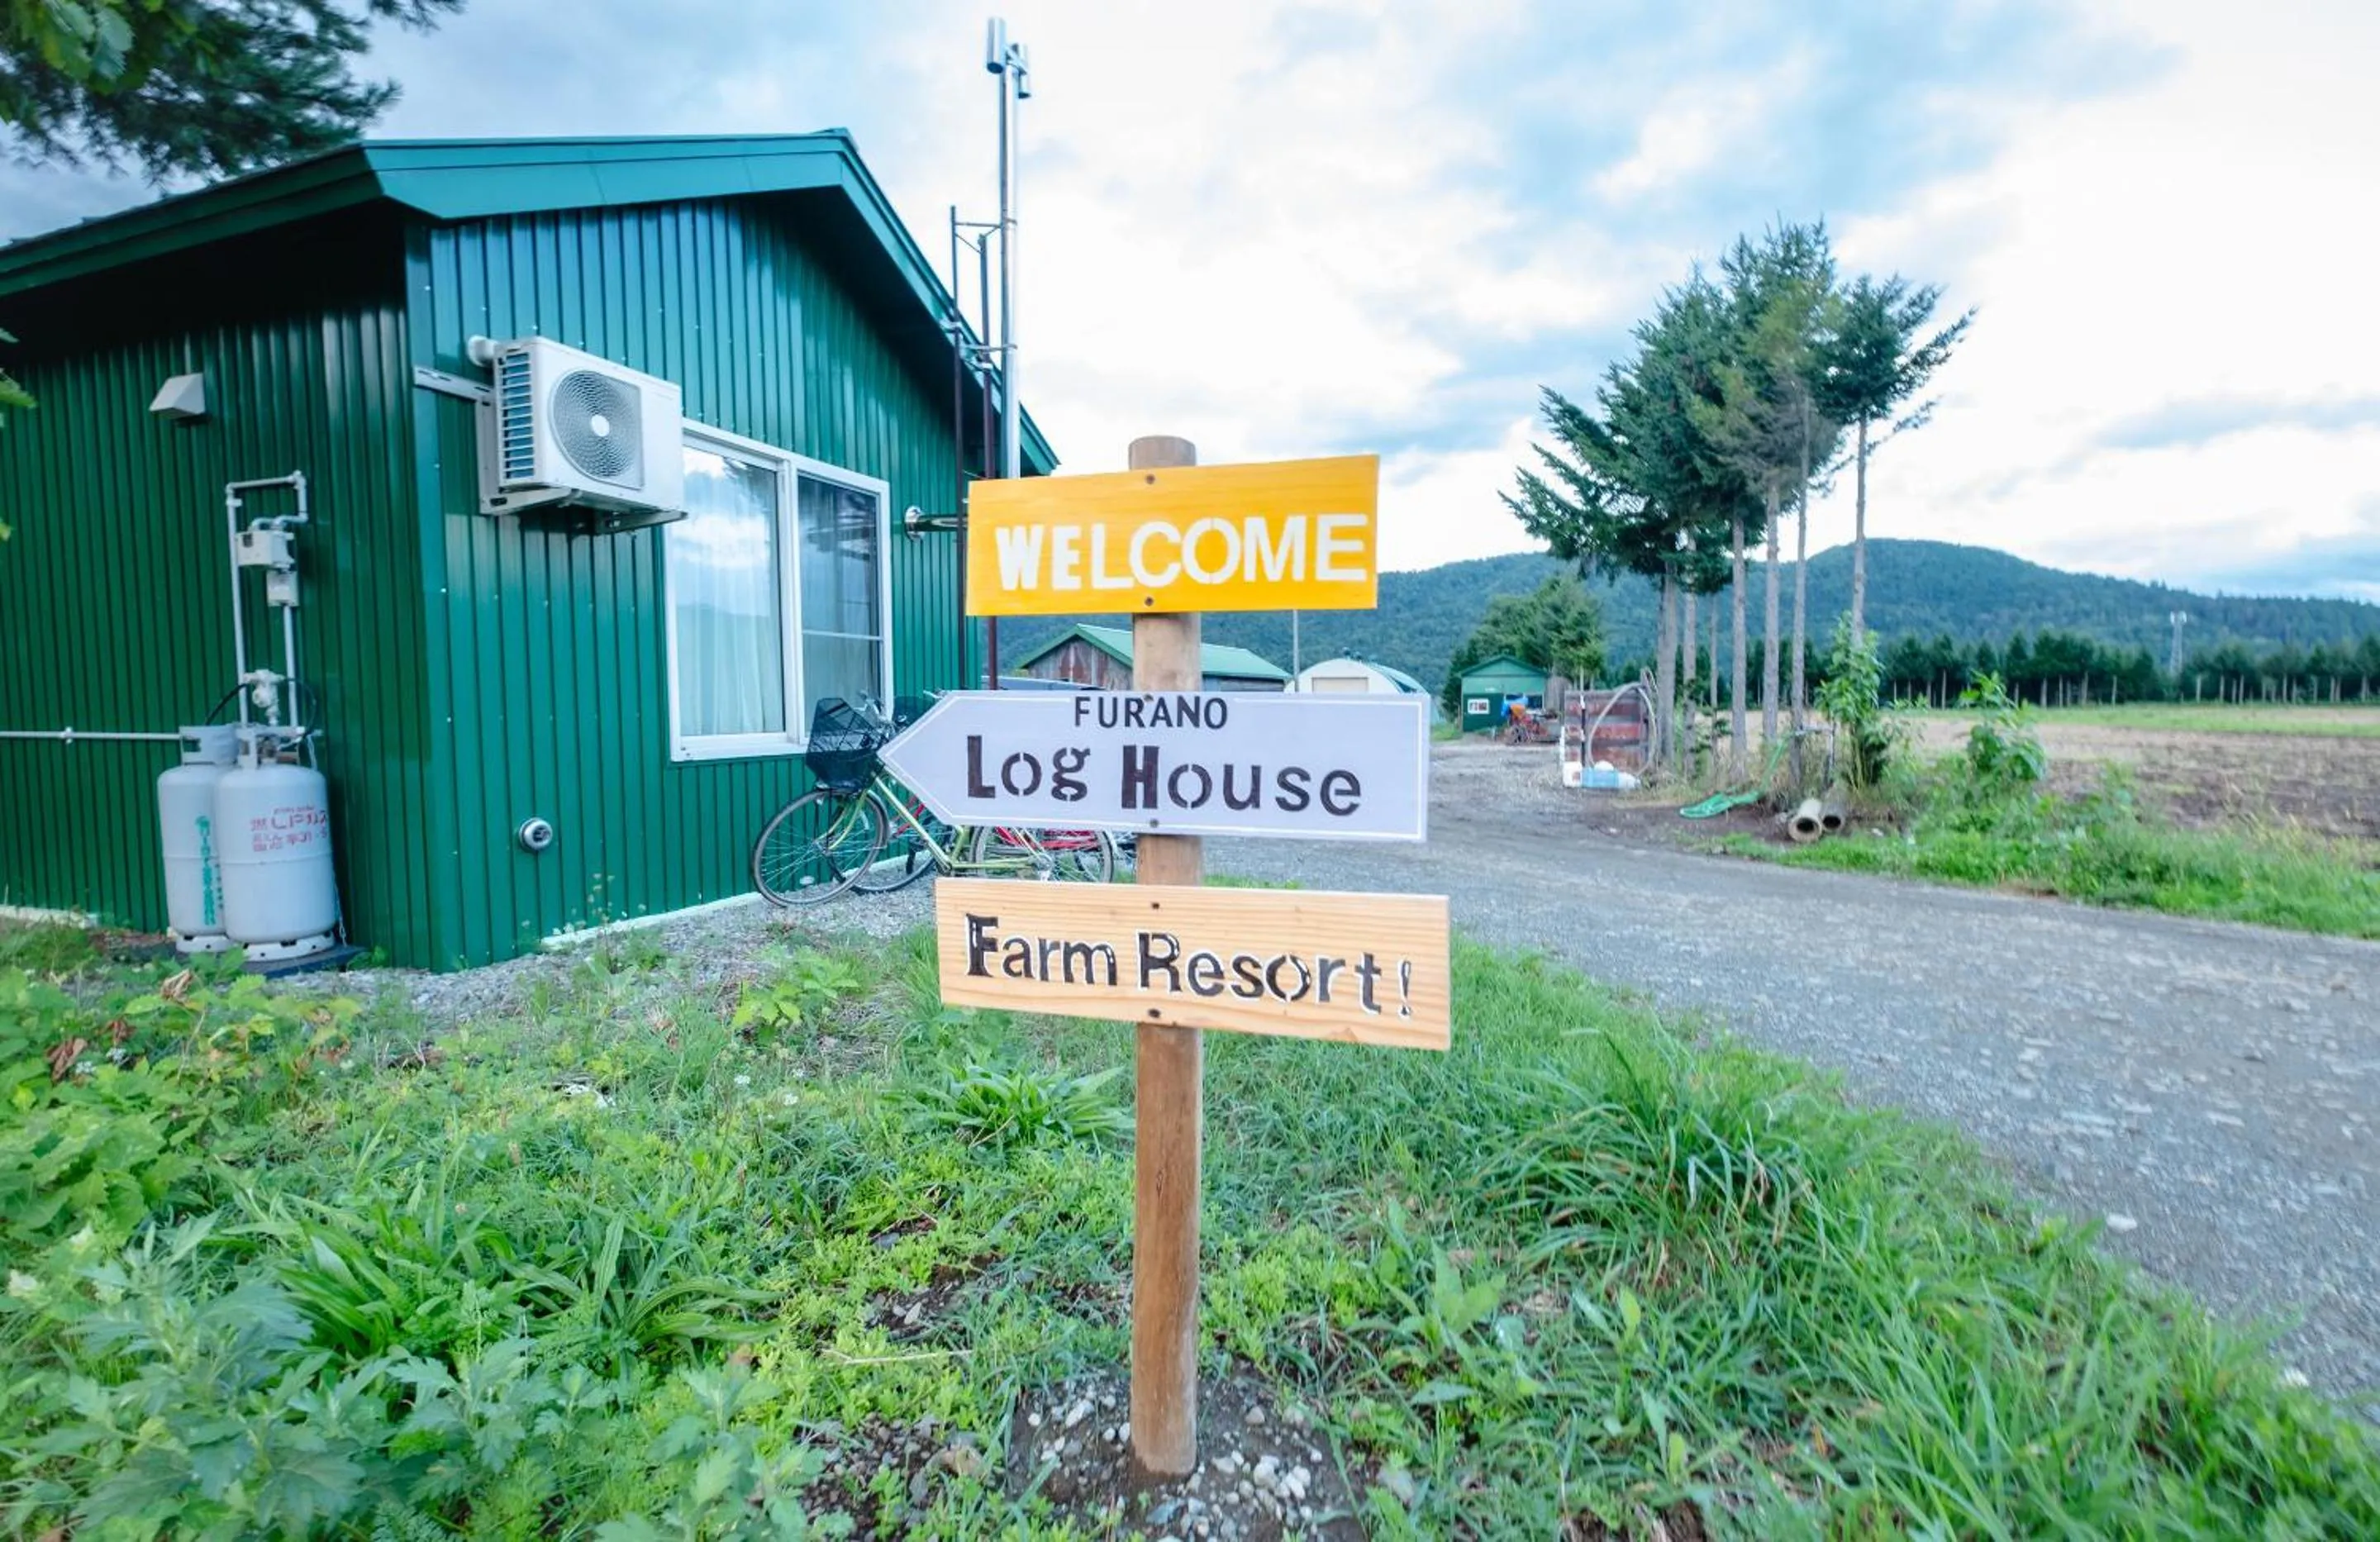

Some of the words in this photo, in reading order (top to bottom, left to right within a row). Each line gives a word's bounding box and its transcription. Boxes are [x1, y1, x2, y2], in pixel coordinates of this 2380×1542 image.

[996, 513, 1368, 591] WELCOME
[1074, 695, 1228, 730] FURANO
[967, 734, 1091, 802] Log
[1121, 745, 1362, 816] House
[965, 912, 1119, 987] Farm
[1137, 932, 1411, 1017] Resort!
